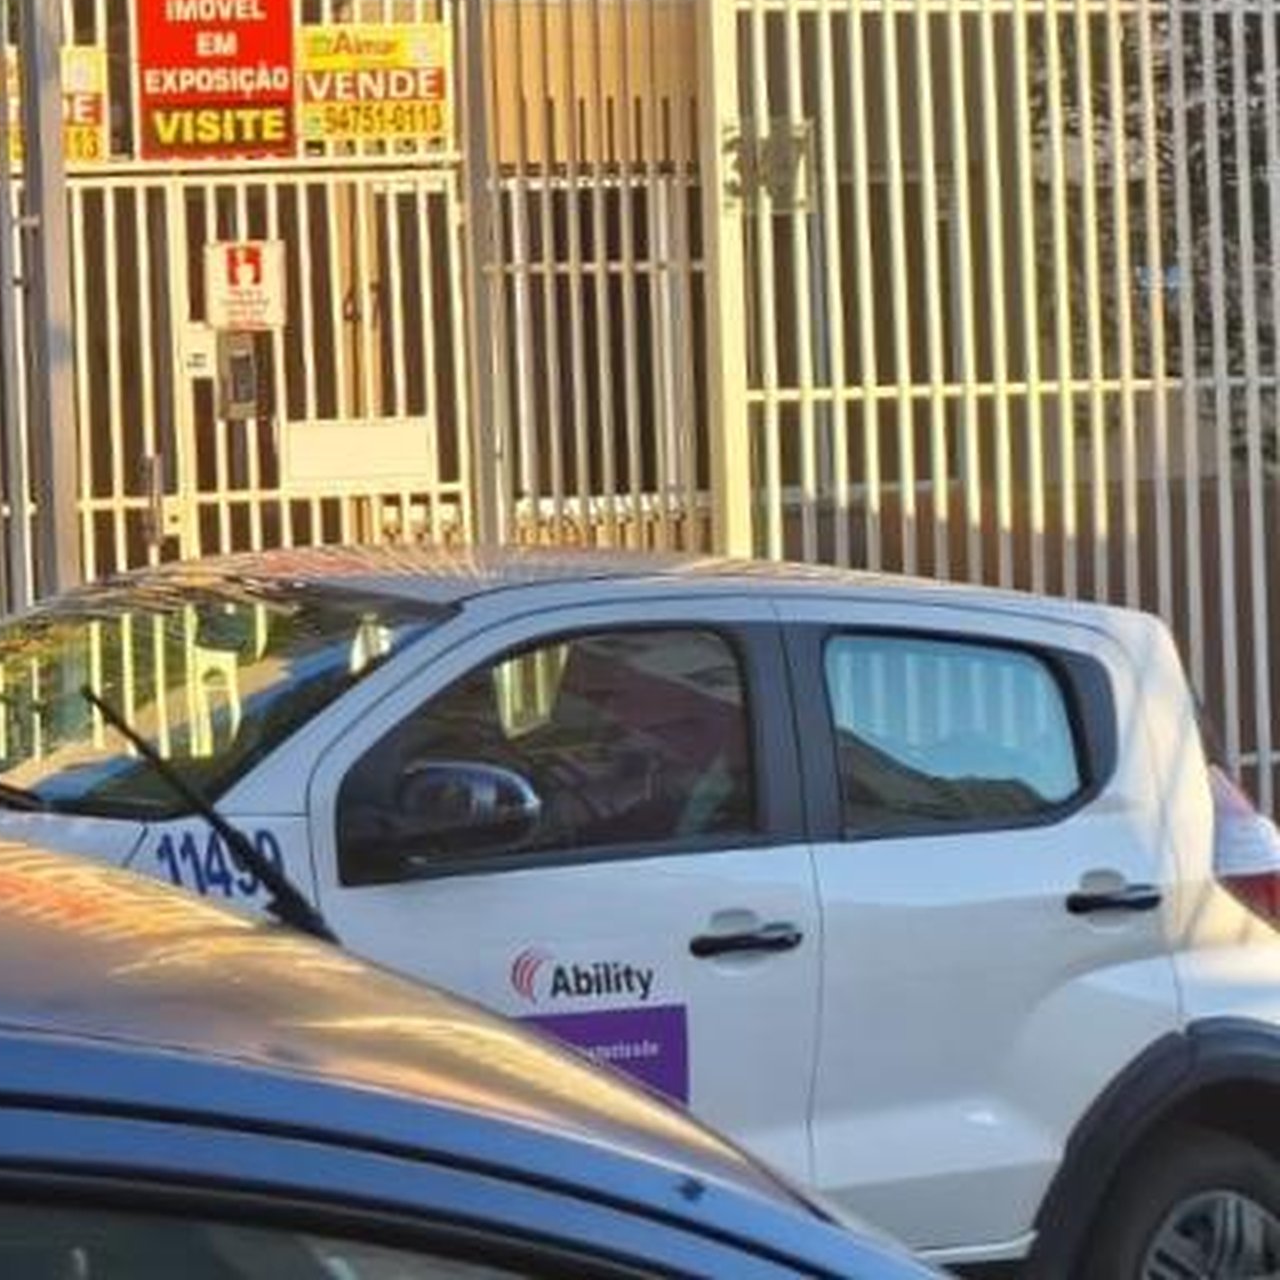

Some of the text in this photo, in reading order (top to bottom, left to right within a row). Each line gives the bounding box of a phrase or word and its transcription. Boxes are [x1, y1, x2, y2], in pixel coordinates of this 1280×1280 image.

[196, 32, 237, 56] EM
[145, 63, 289, 98] EXPOSIÇÃO
[305, 68, 440, 100] VENDE
[155, 110, 287, 144] VISITE
[551, 961, 654, 1000] Ability
